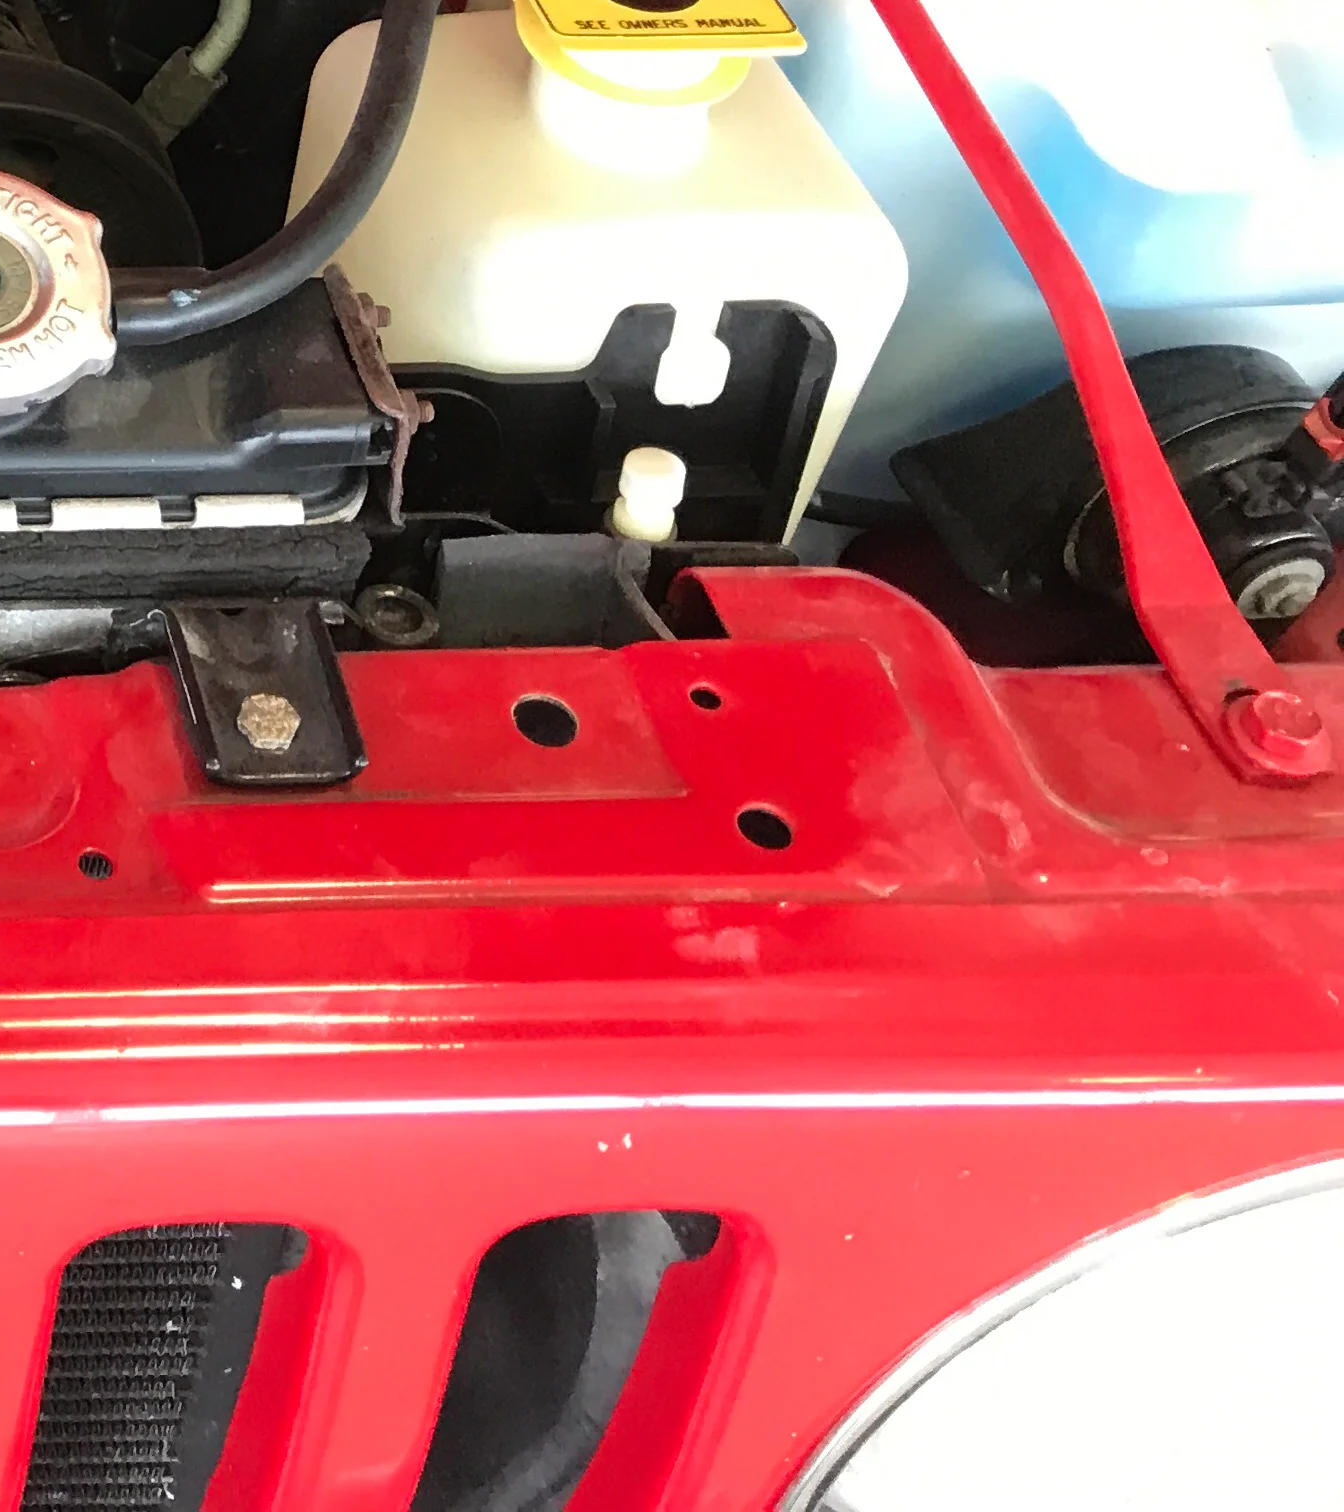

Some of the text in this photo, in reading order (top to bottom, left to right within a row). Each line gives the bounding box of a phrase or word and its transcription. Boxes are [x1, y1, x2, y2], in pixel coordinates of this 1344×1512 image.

[574, 17, 767, 31] SEE OWNERS MANUAL
[33, 298, 85, 352] HOT
